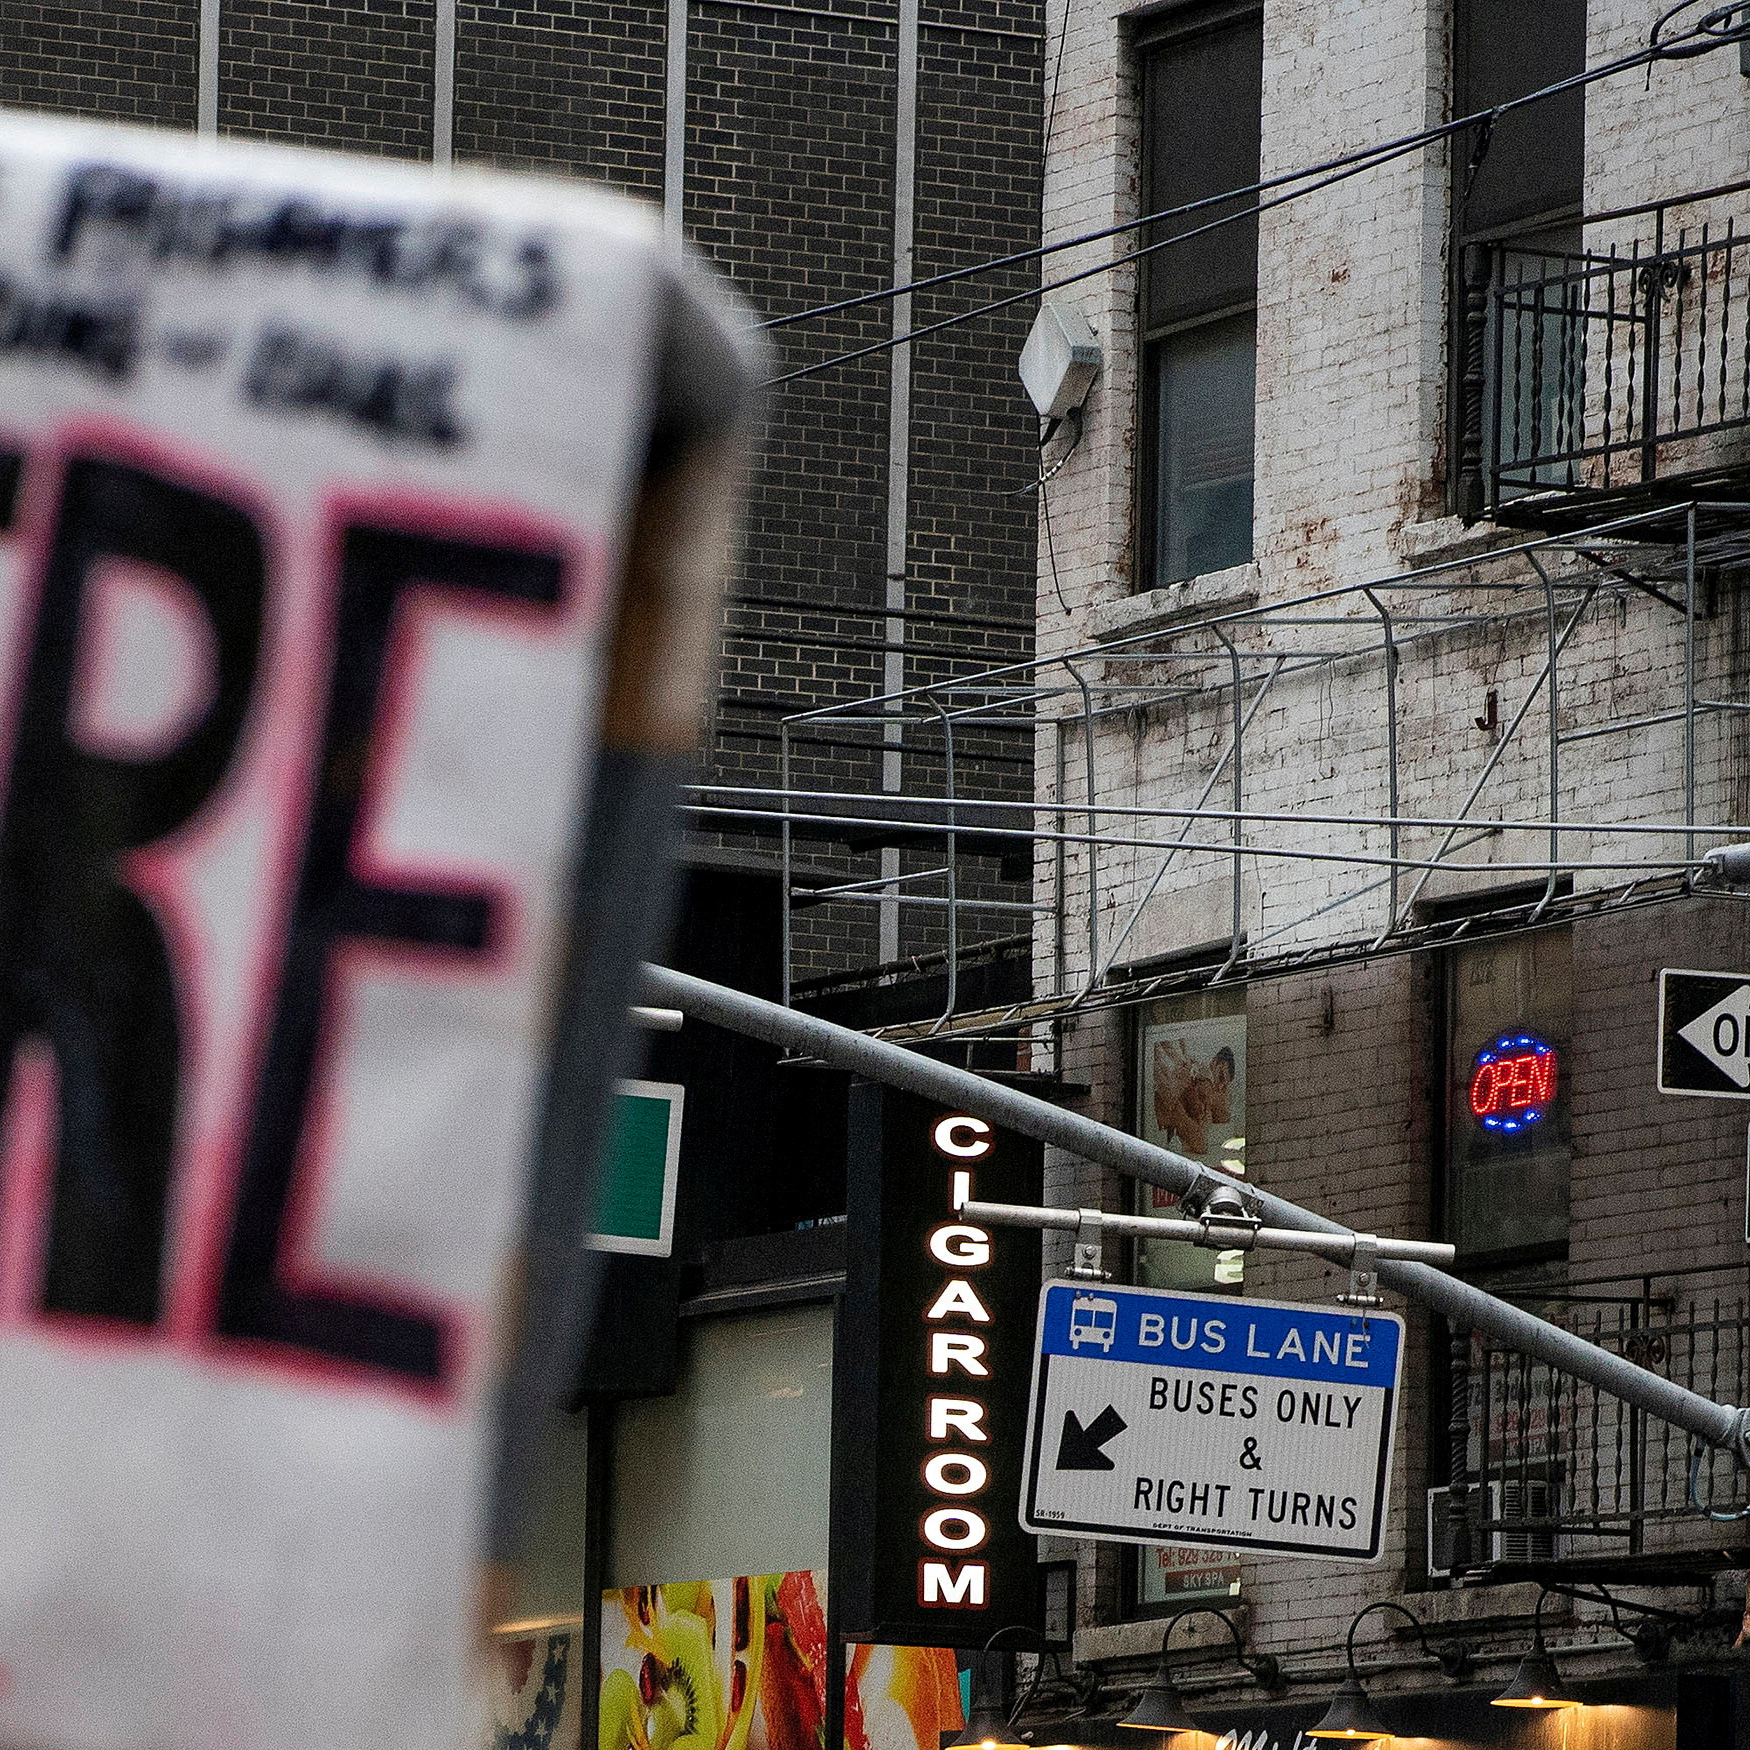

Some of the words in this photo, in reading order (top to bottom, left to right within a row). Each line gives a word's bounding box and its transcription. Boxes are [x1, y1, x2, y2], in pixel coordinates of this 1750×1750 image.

[1472, 1051, 1556, 1114] OPEN
[927, 1116, 991, 1376] CIGAR
[1139, 1313, 1228, 1354] BUS
[1247, 1323, 1371, 1369] LANE
[1149, 1376, 1259, 1420] BUSES
[1276, 1389, 1363, 1430] ONLY
[1239, 1436, 1262, 1471] &
[923, 1398, 989, 1605] ROOM
[1134, 1477, 1231, 1519] RIGHT
[1248, 1487, 1358, 1531] TURNS
